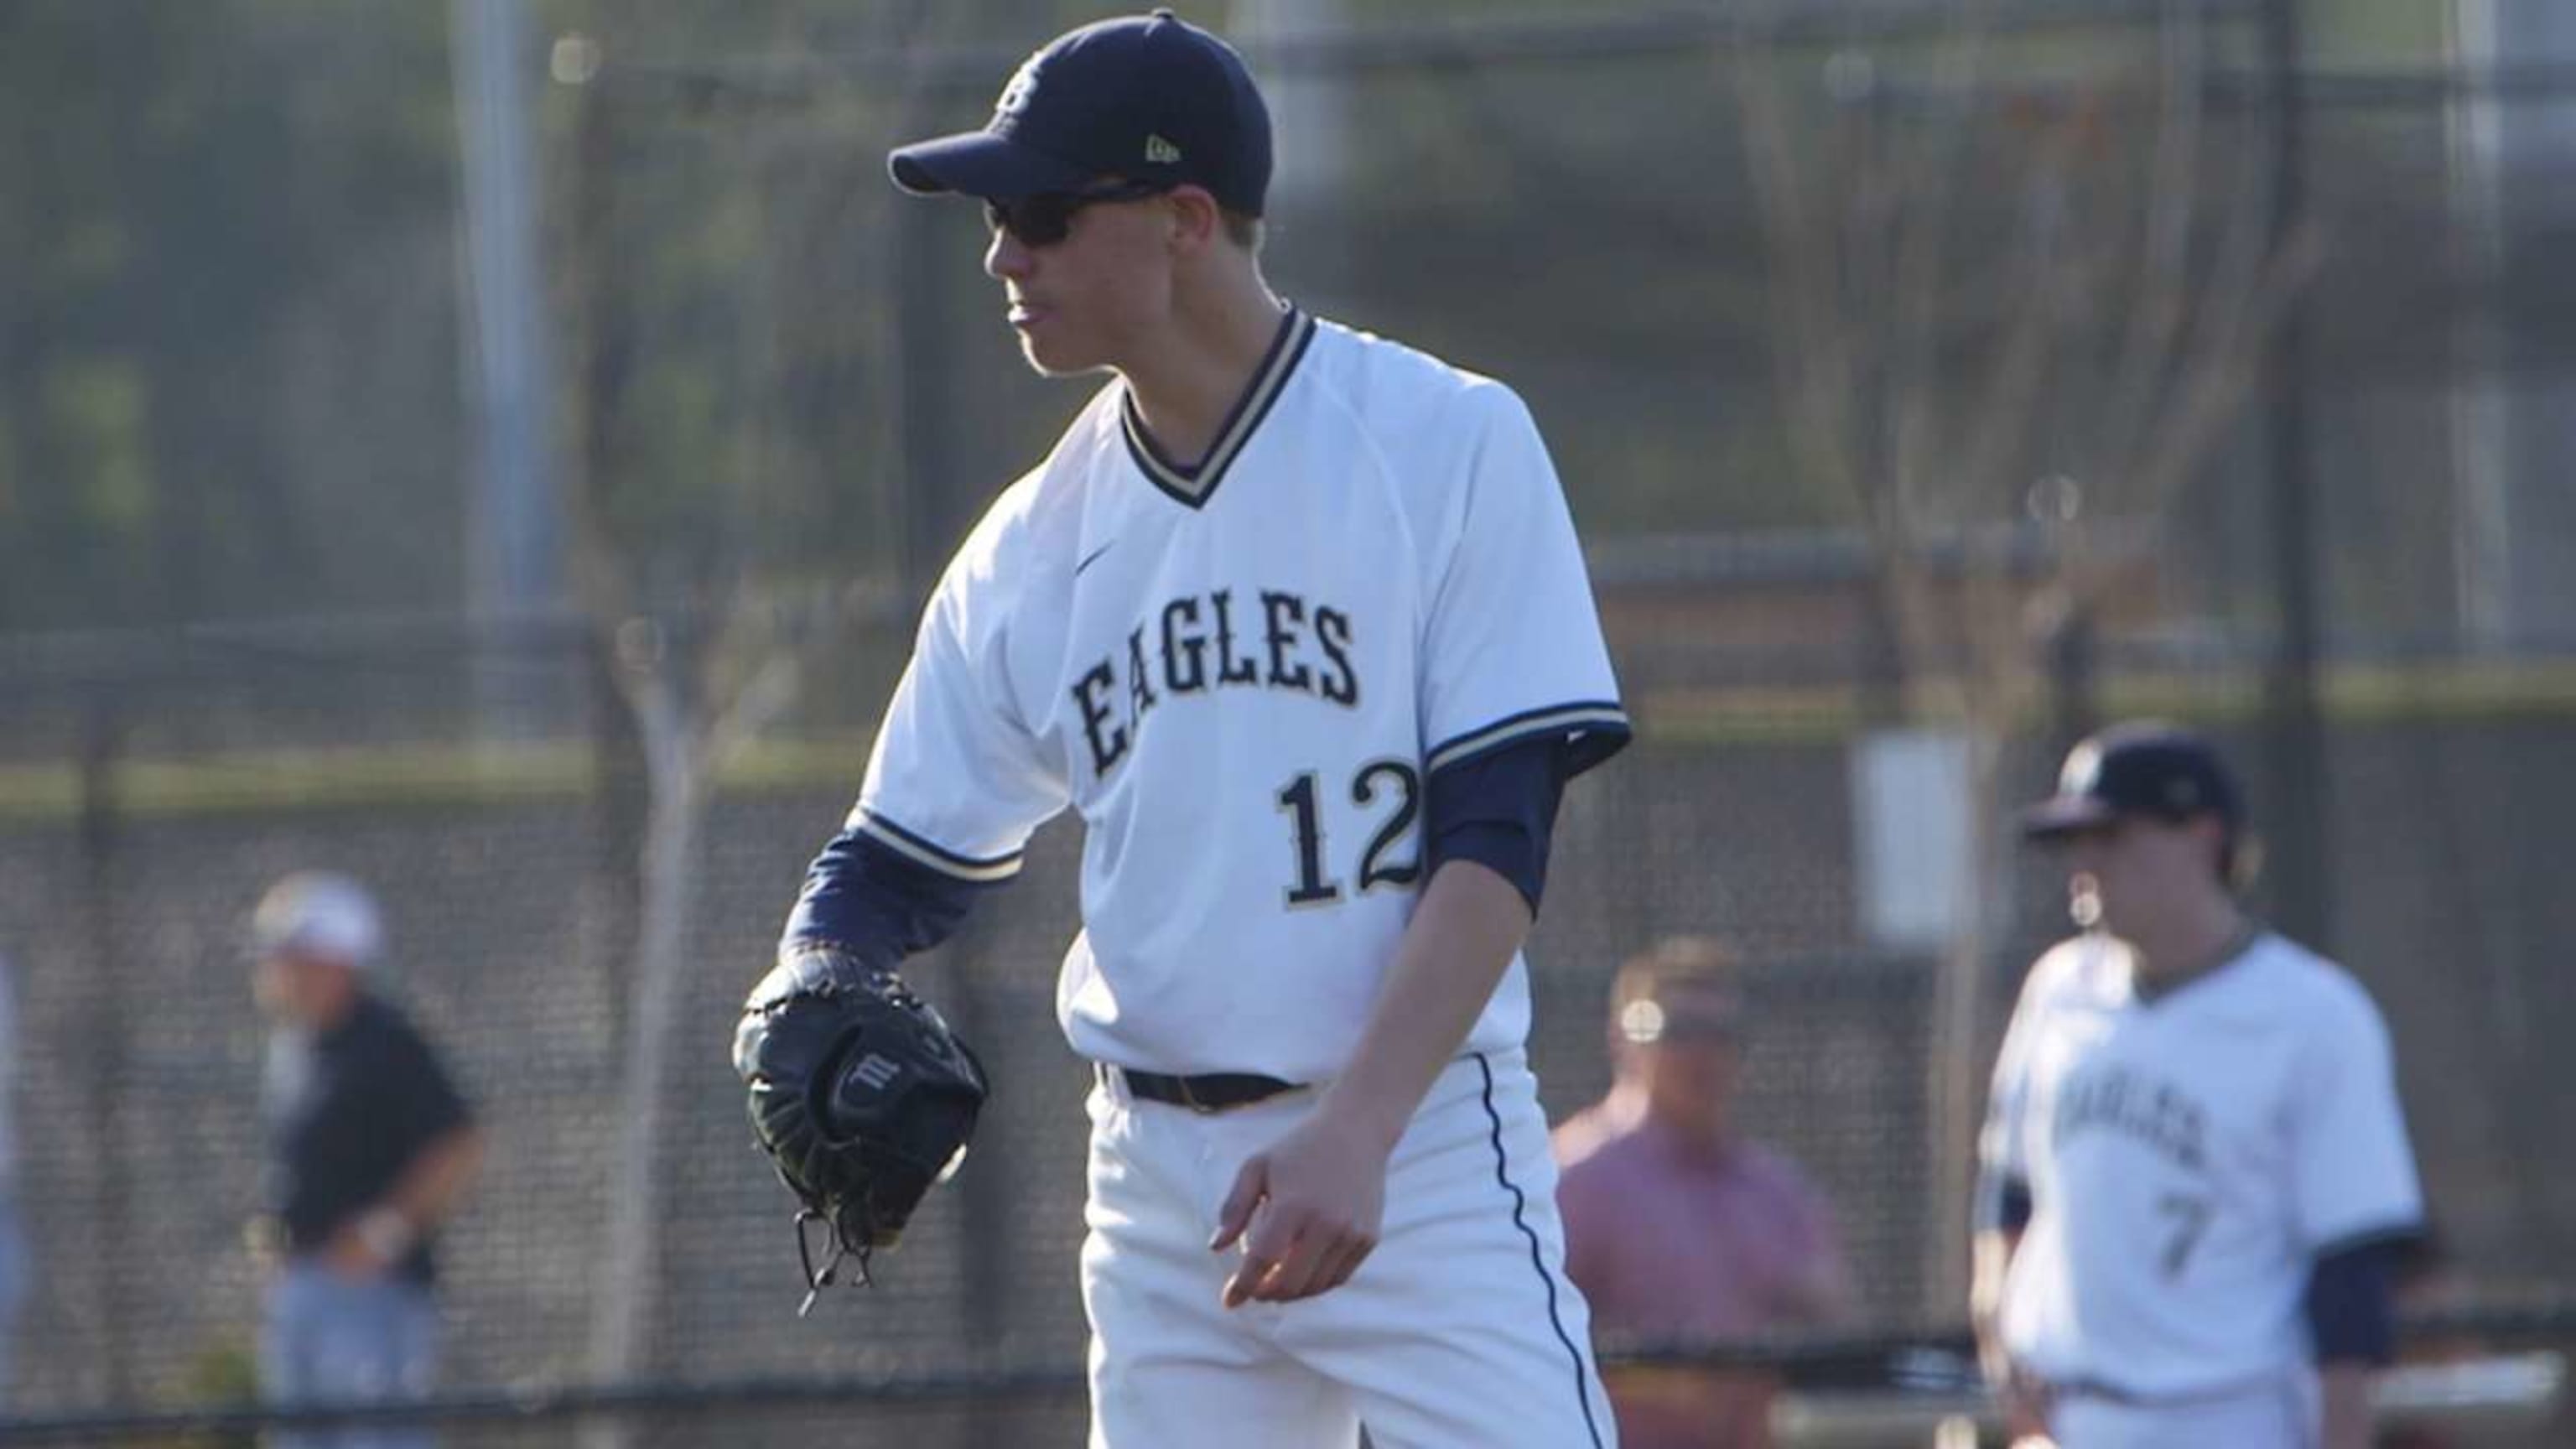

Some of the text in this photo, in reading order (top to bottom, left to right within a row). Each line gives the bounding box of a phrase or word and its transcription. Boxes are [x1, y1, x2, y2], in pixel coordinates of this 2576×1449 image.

[1072, 587, 1359, 780] EAGLES
[1277, 759, 1420, 909] 12
[2153, 1189, 2215, 1285] 7
